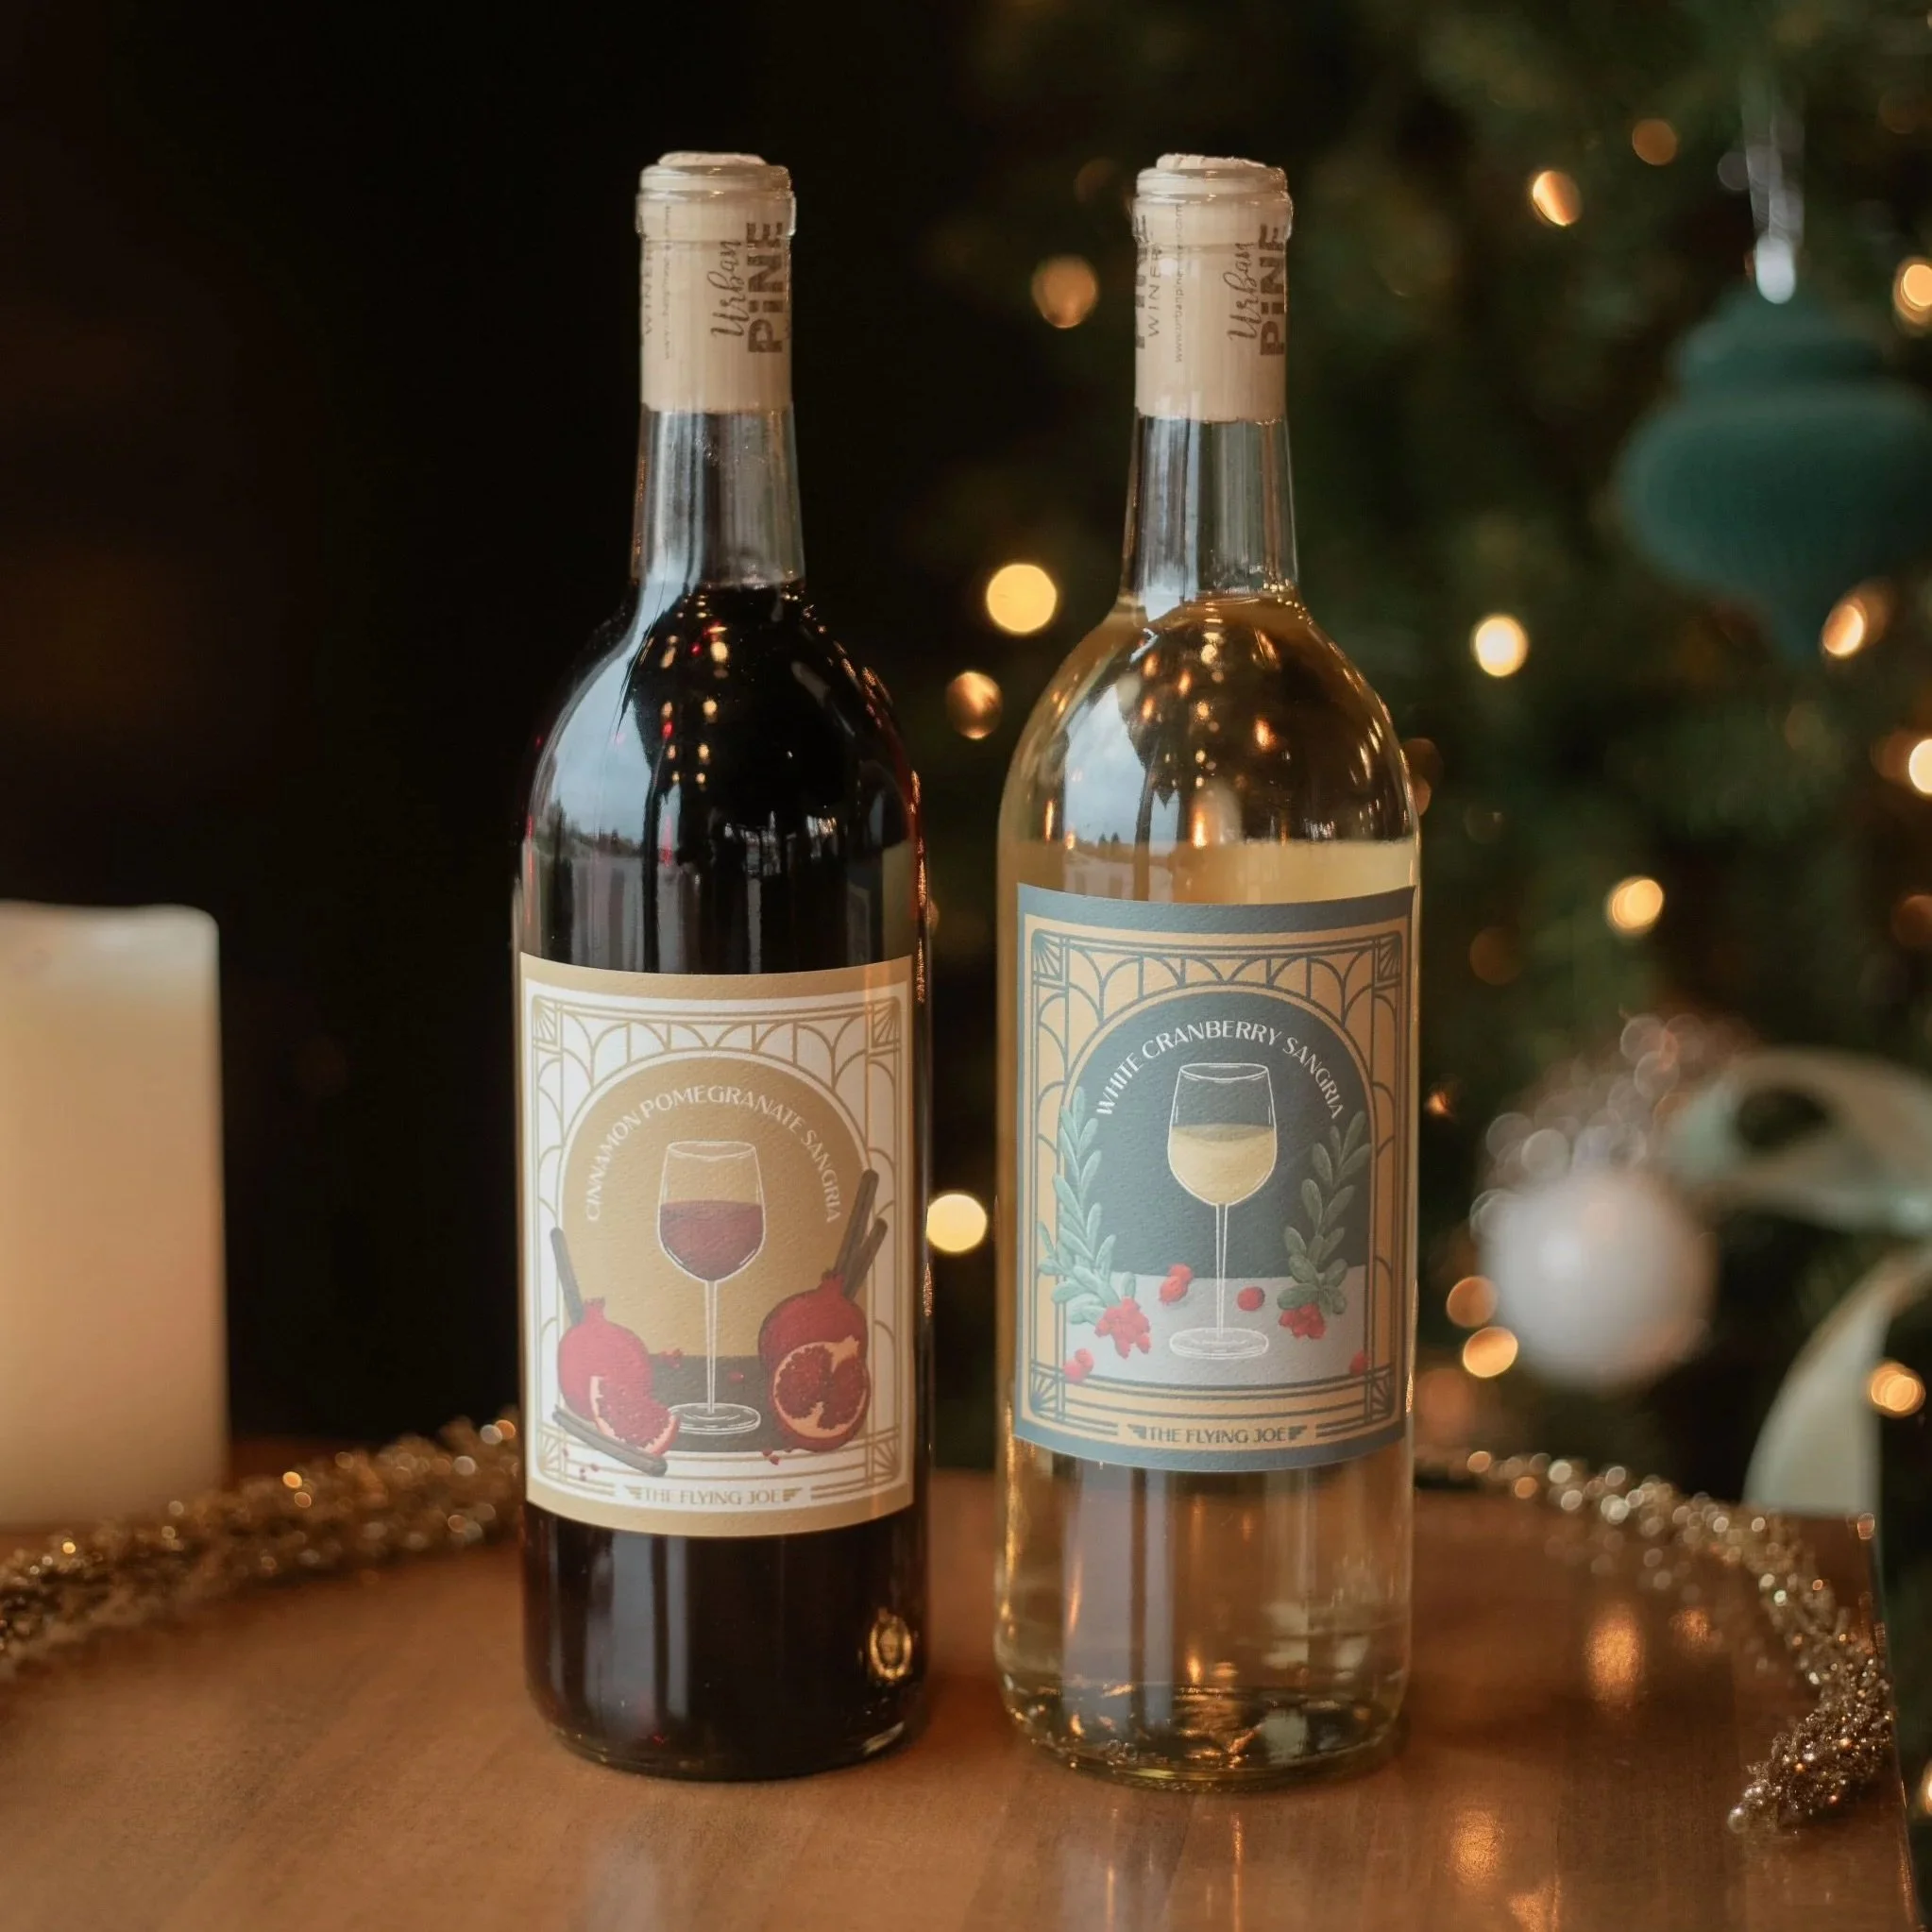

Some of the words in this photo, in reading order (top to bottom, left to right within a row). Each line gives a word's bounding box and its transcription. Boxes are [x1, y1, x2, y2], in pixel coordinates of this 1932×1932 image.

[708, 240, 750, 338] Urban
[1223, 242, 1262, 340] Urban
[1096, 1053, 1144, 1115] WHITE
[1142, 1020, 1282, 1059] CRANBERRY
[1282, 1037, 1344, 1119] SANGRIA
[585, 1110, 641, 1222] CINNAMON
[639, 1085, 804, 1133] POMEGRANATE
[802, 1129, 841, 1223] SANGRIA
[1149, 1427, 1181, 1442] THE
[1186, 1429, 1248, 1444] FLYING
[1252, 1427, 1286, 1443] JOE
[644, 1487, 671, 1502] THE
[680, 1490, 742, 1505] FLYING
[747, 1489, 783, 1504] JOE
